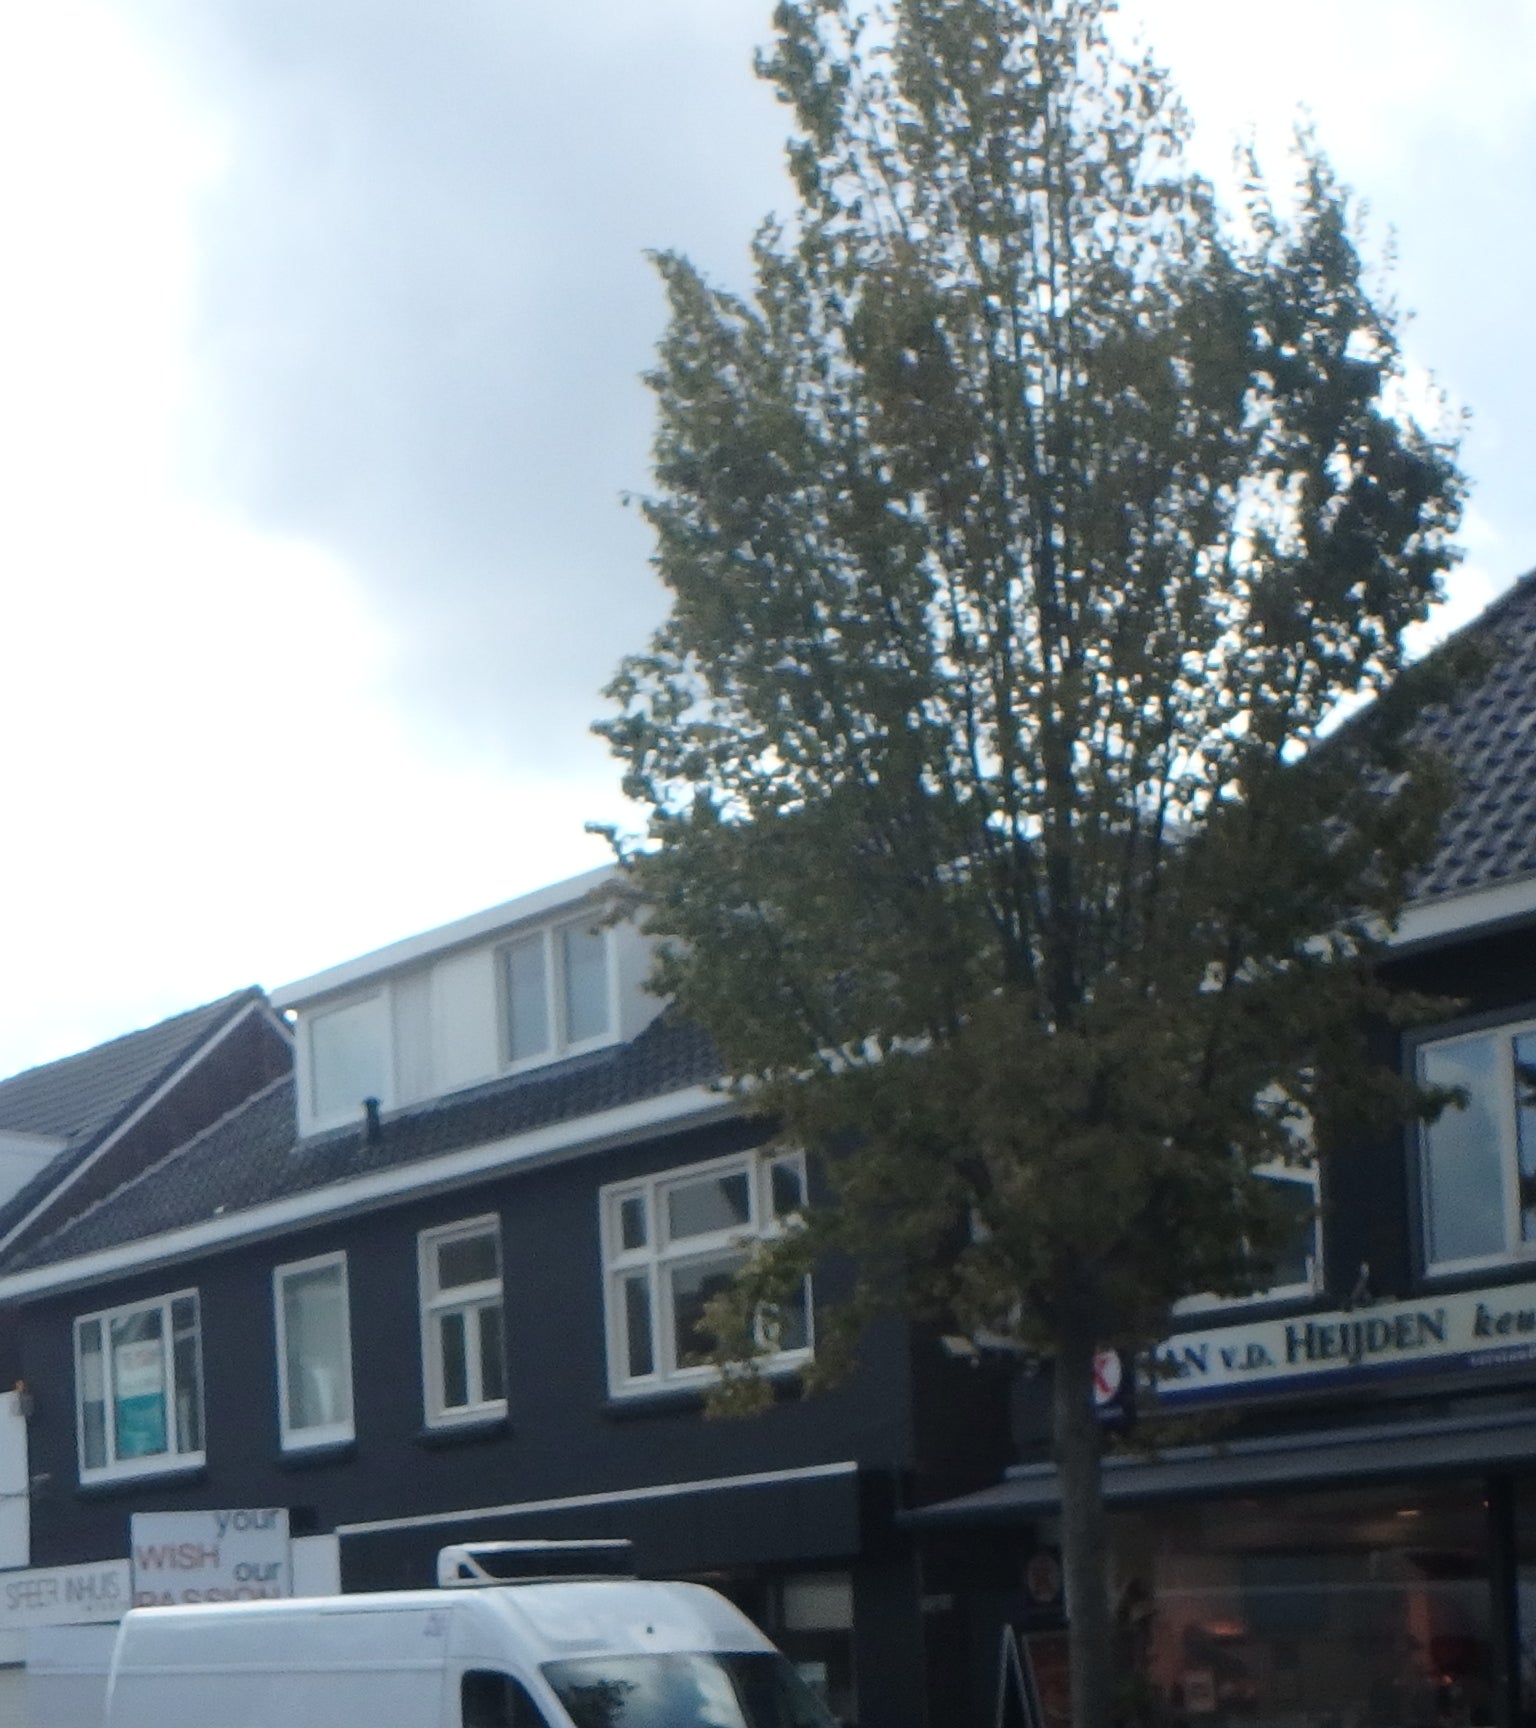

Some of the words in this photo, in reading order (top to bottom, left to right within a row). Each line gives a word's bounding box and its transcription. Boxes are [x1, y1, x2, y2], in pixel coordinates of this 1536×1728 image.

[1284, 1306, 1446, 1366] HEIJDEN
[215, 1509, 280, 1539] your
[135, 1543, 221, 1571] WISH
[233, 1561, 282, 1582] our
